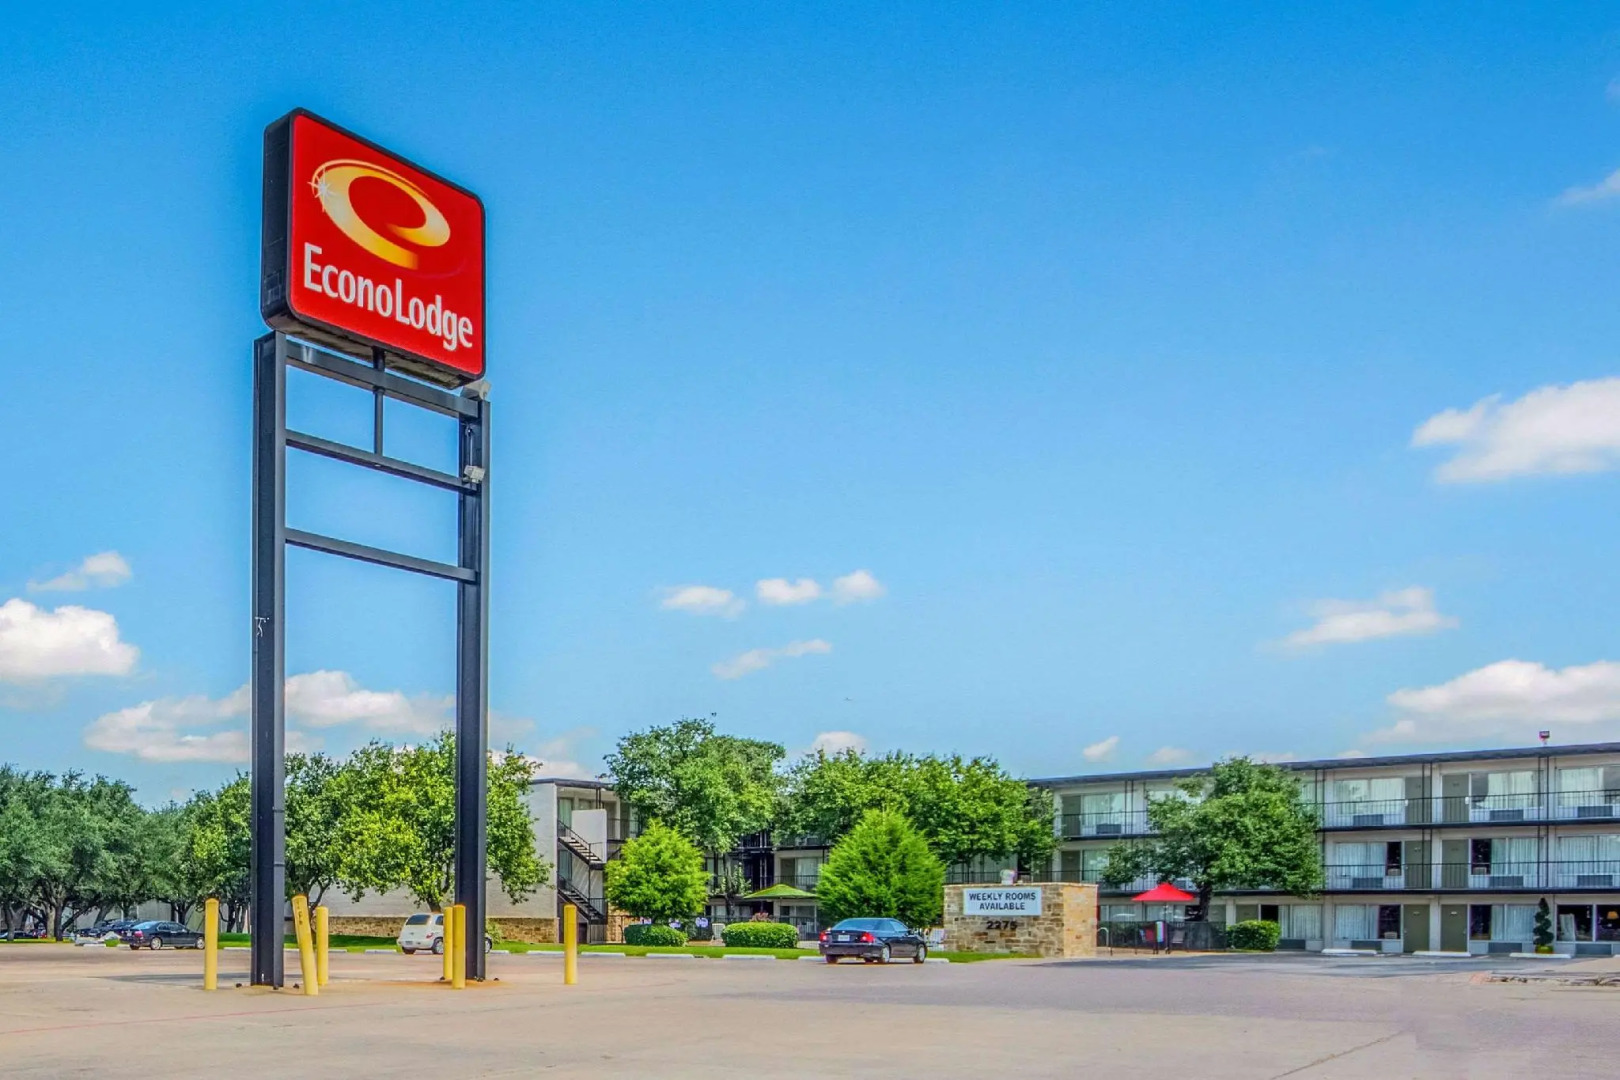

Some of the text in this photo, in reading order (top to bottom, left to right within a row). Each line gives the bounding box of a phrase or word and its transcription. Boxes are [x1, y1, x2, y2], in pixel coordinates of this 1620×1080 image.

[304, 242, 473, 351] EconoLodge
[969, 892, 1036, 901] WEEKLY ROOMS
[979, 902, 1025, 911] AVAILABLE
